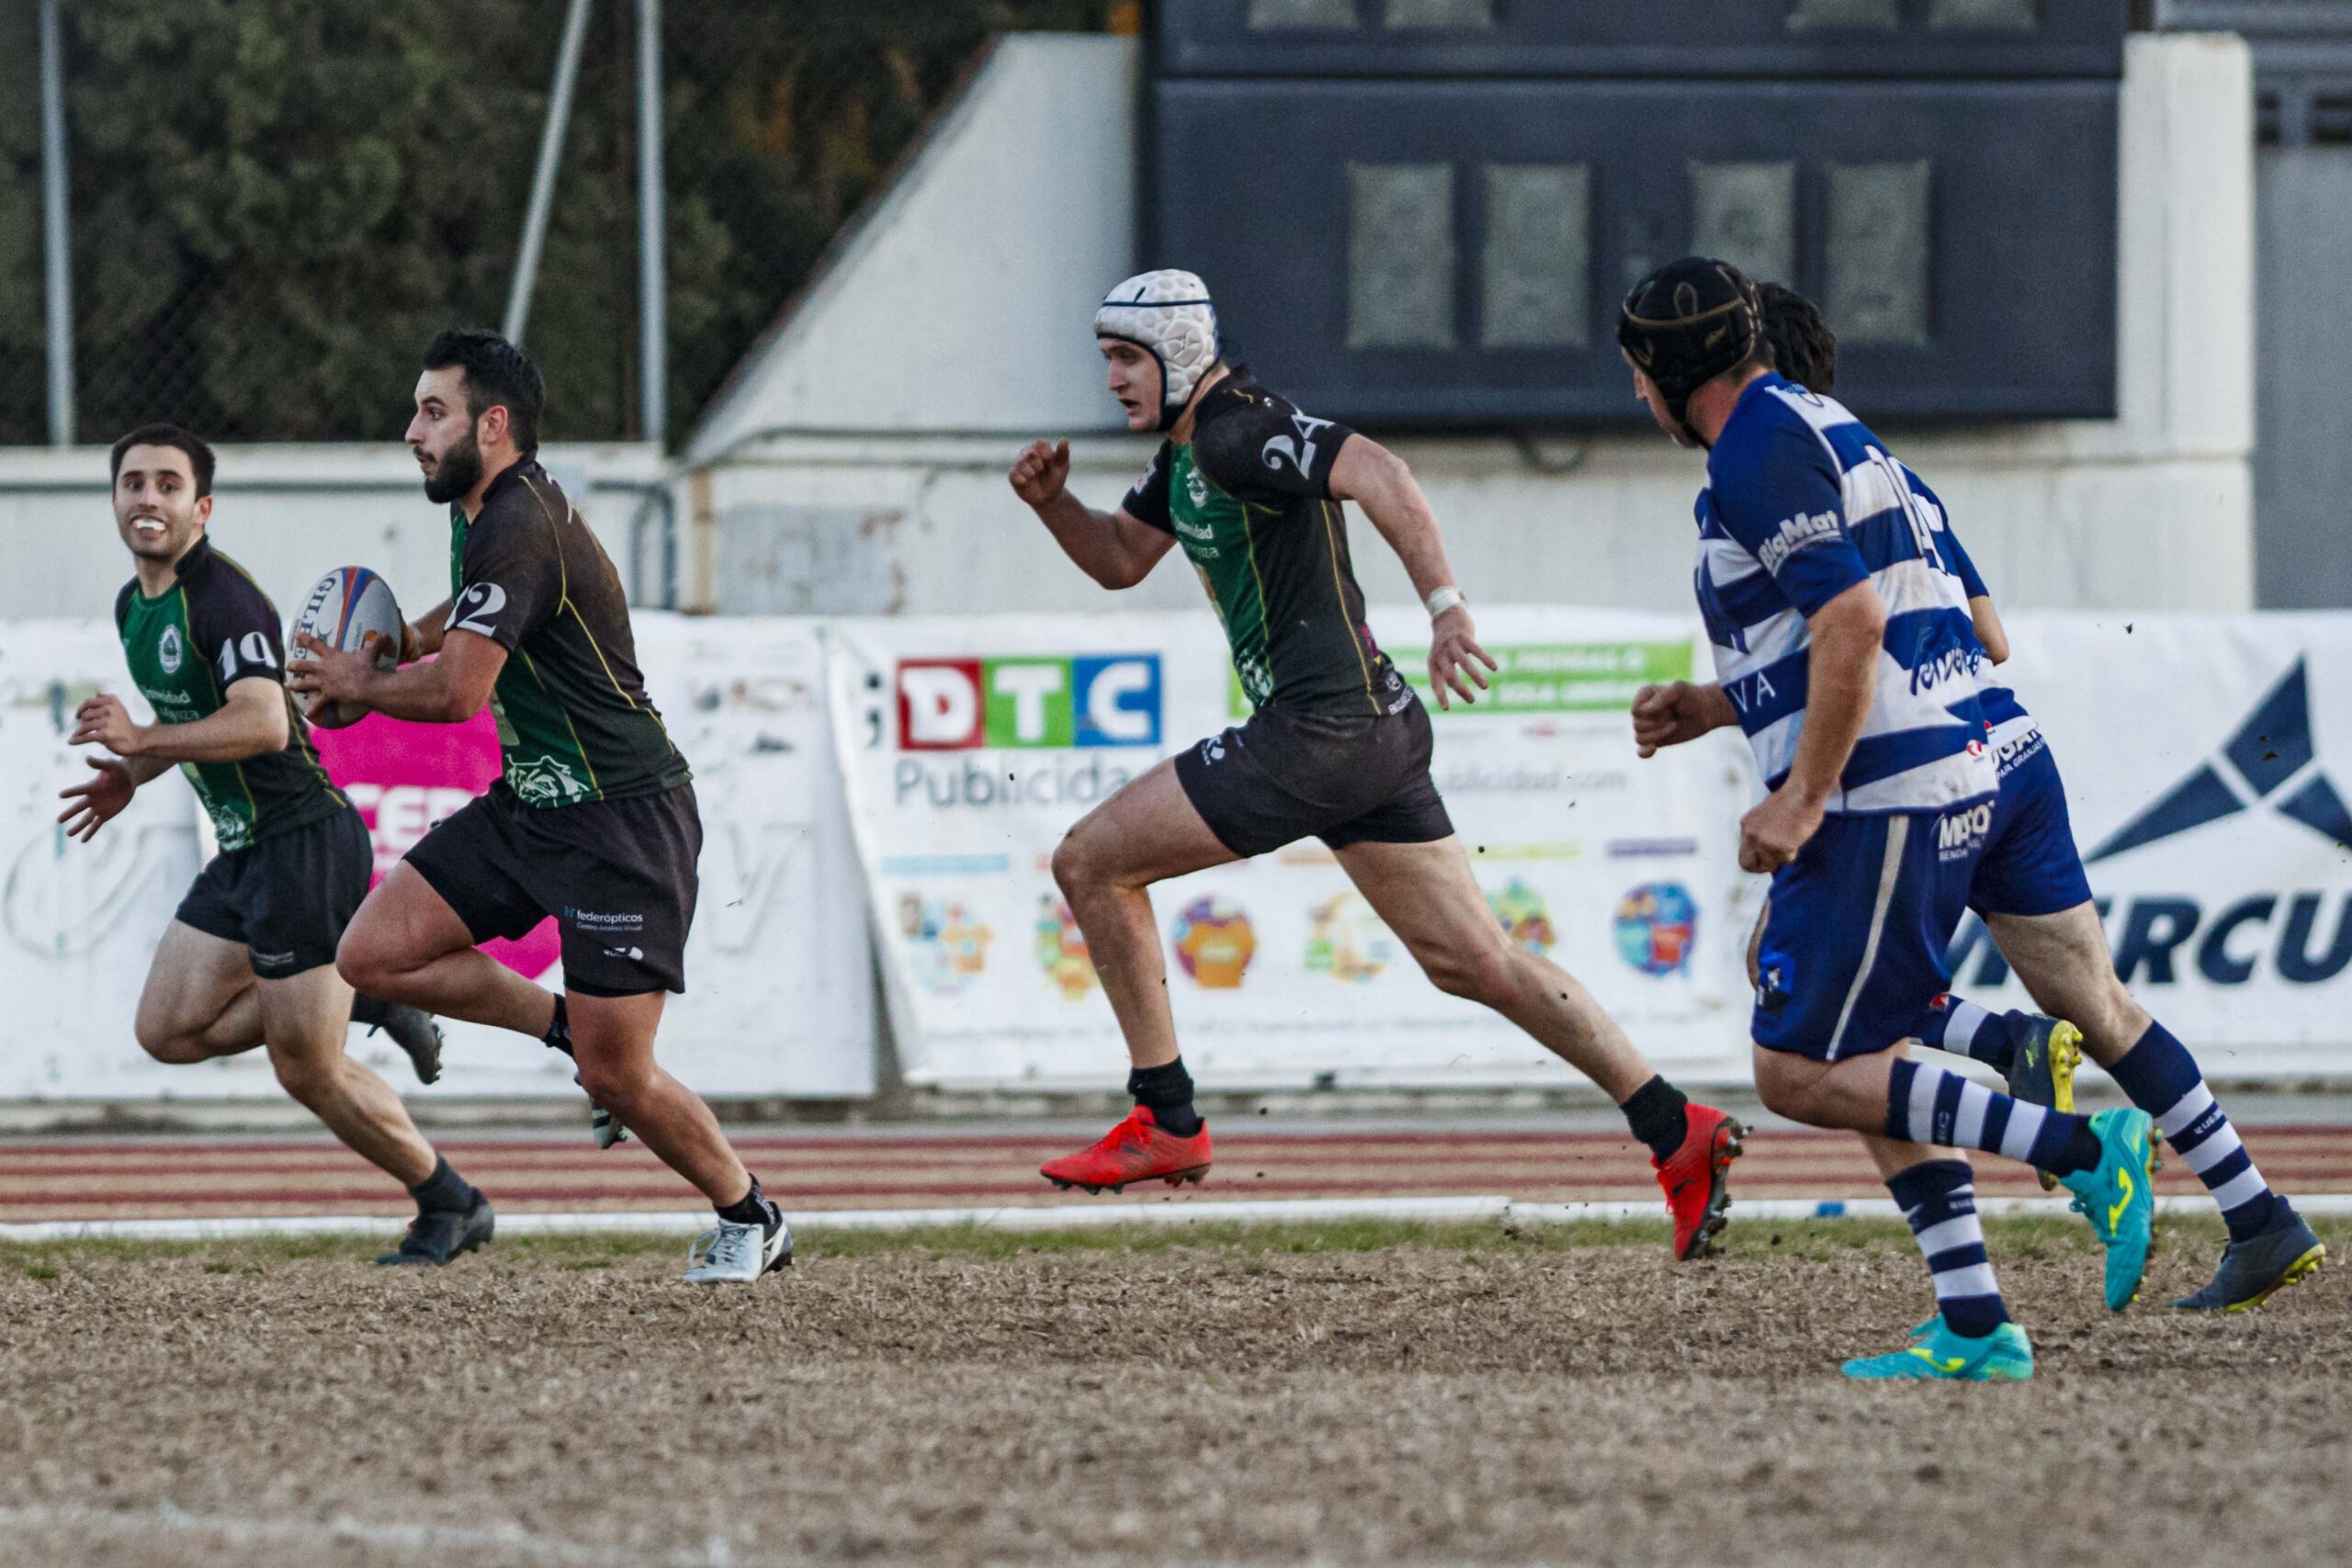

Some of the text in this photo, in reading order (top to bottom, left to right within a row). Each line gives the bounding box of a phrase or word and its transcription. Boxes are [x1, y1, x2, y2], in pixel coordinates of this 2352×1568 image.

[1261, 412, 1336, 480] 24
[1758, 510, 1840, 578] BigMat
[899, 660, 1149, 741] DTC
[895, 751, 1134, 807] Publicida
[576, 909, 643, 924] federópticos
[1943, 889, 2352, 987] MRCU
